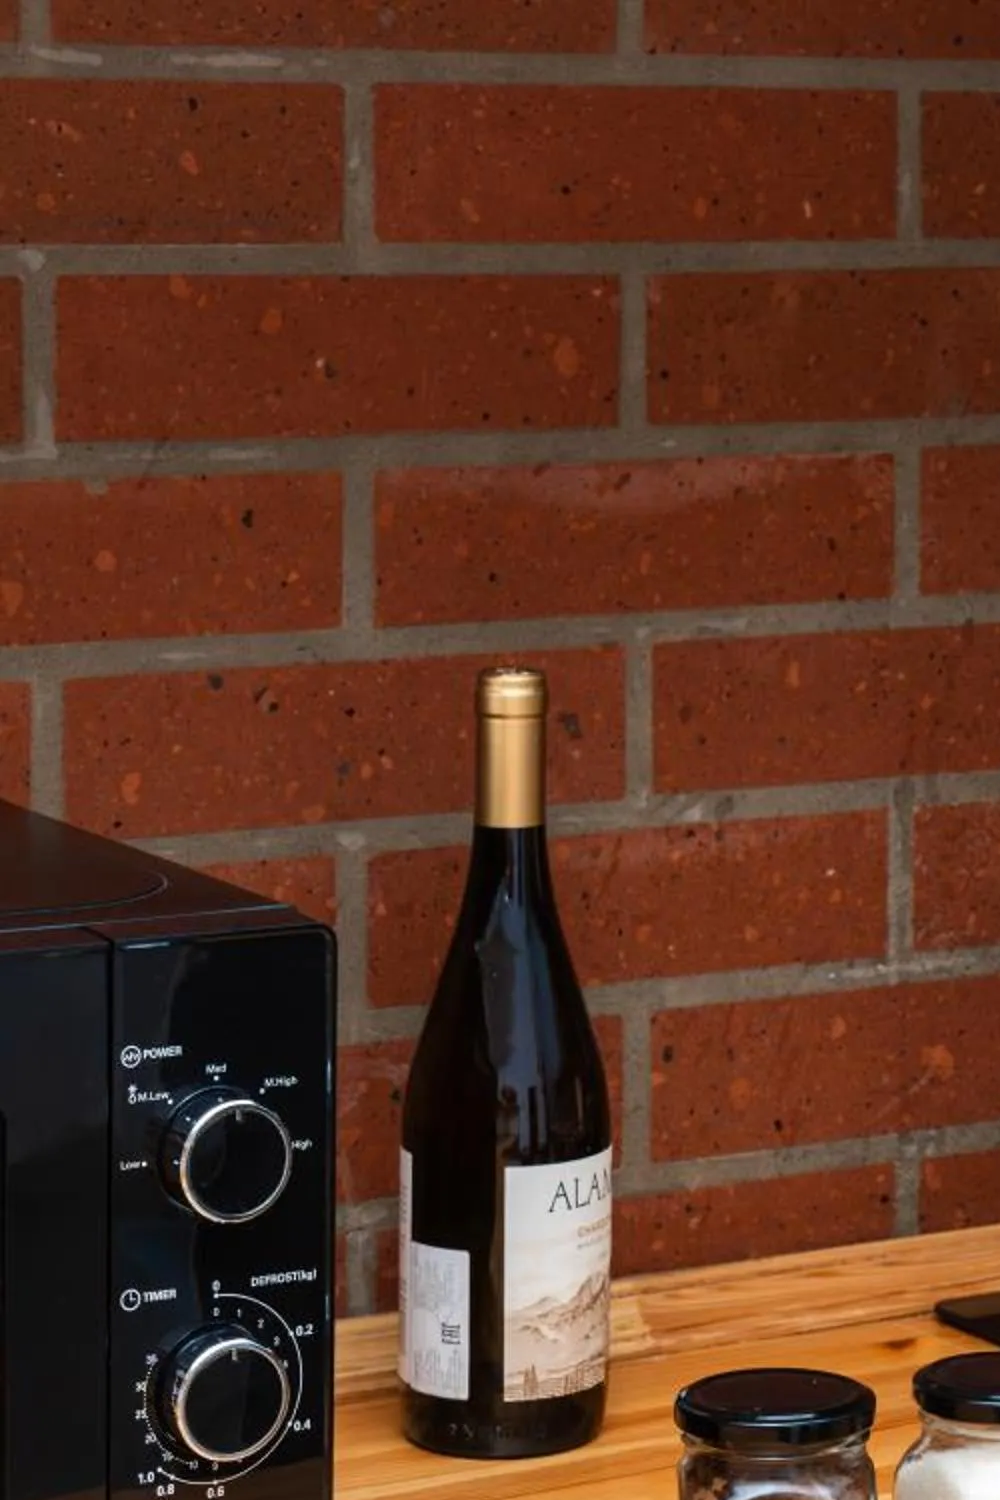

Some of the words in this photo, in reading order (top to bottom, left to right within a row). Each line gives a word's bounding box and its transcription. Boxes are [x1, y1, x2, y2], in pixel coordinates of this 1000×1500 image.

[143, 1045, 183, 1060] POWER
[206, 1064, 227, 1075] Med
[264, 1075, 299, 1088] M.High
[137, 1092, 170, 1103] M.Low
[119, 1160, 141, 1172] Low
[212, 1279, 221, 1292] 0
[142, 1288, 177, 1303] TIMER
[257, 1318, 265, 1329] 2
[295, 1323, 315, 1337] 0.2
[293, 1419, 312, 1432] 0.4
[138, 1472, 155, 1485] 1.0
[157, 1484, 175, 1498] 0.8
[207, 1486, 225, 1499] 0.6
